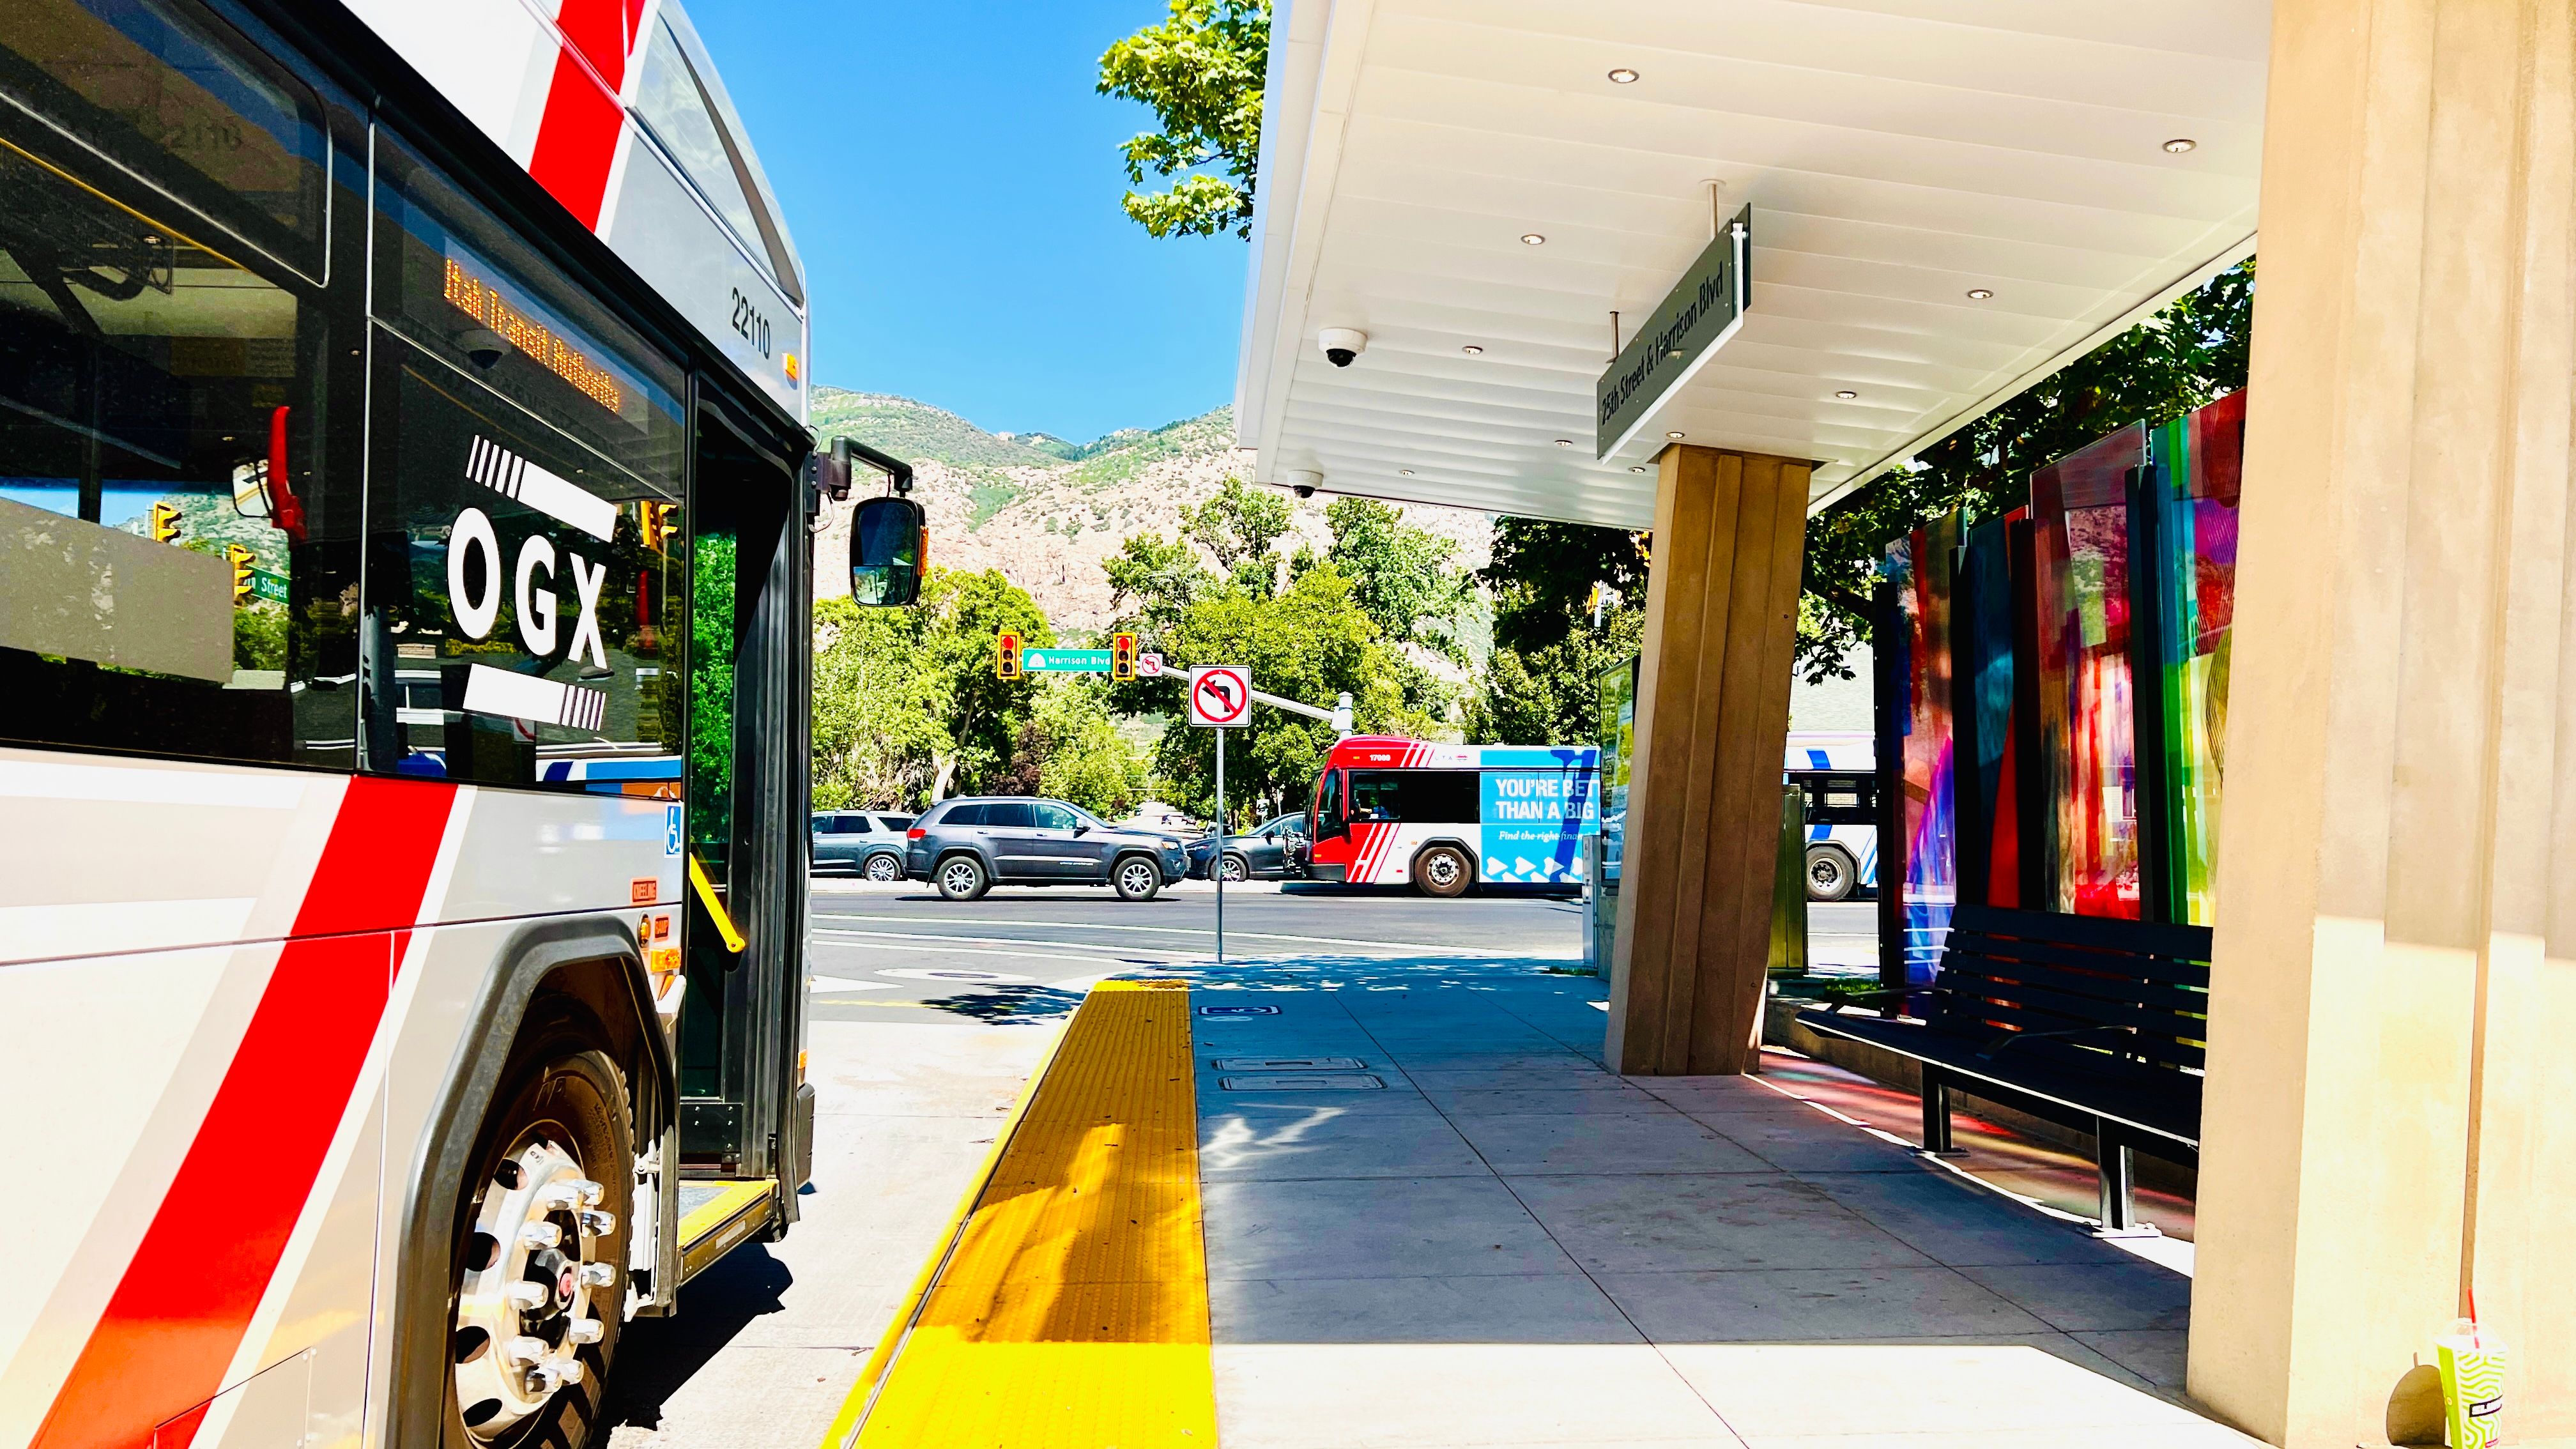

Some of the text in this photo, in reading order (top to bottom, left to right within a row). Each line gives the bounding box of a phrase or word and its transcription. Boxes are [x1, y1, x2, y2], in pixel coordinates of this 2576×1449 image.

[732, 287, 770, 360] 22110
[1602, 260, 1723, 425] 25th Street & Harrison Blvd
[261, 577, 287, 599] Street
[448, 507, 607, 670] OGX
[1048, 656, 1087, 664] Harrison
[1091, 656, 1110, 665] Blvd
[1496, 779, 1558, 797] YOU'RE
[1496, 801, 1594, 820] THAN A BIG
[1499, 831, 1519, 840] Find
[1521, 831, 1535, 840] the
[1535, 831, 1560, 843] right
